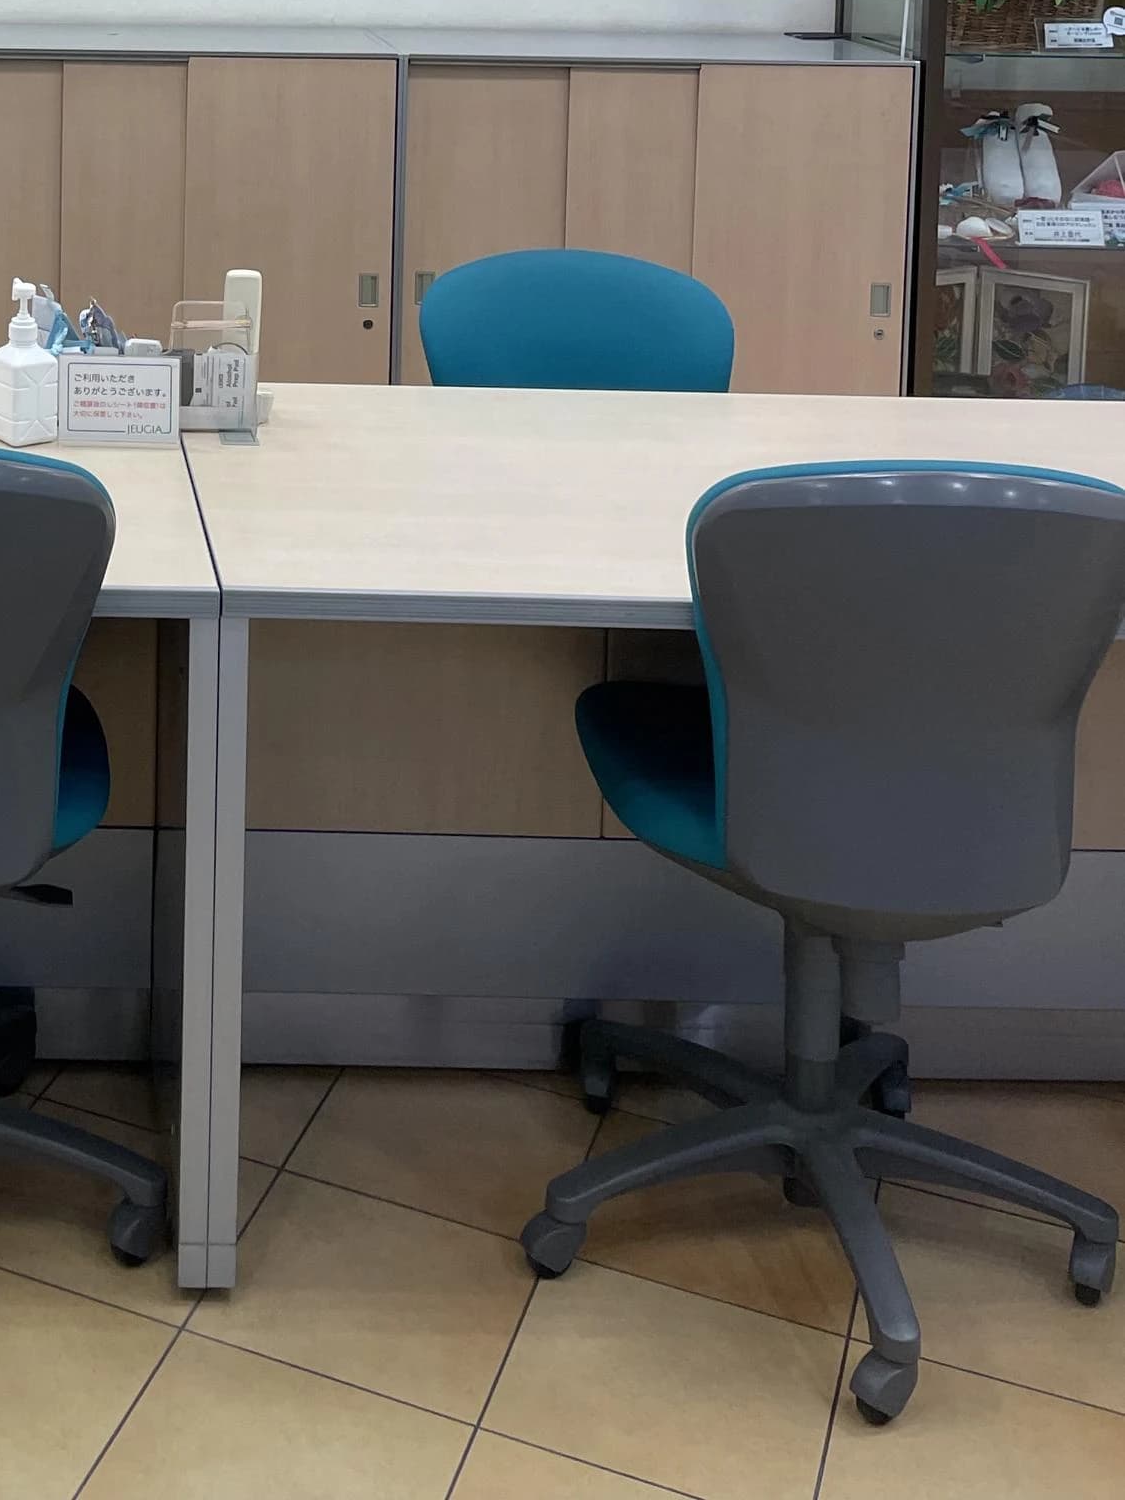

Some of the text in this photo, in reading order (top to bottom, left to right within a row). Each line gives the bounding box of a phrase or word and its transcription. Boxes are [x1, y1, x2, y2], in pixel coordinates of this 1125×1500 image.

[74, 373, 135, 383] ご利用いただき
[74, 387, 167, 398] ありがとうございます。
